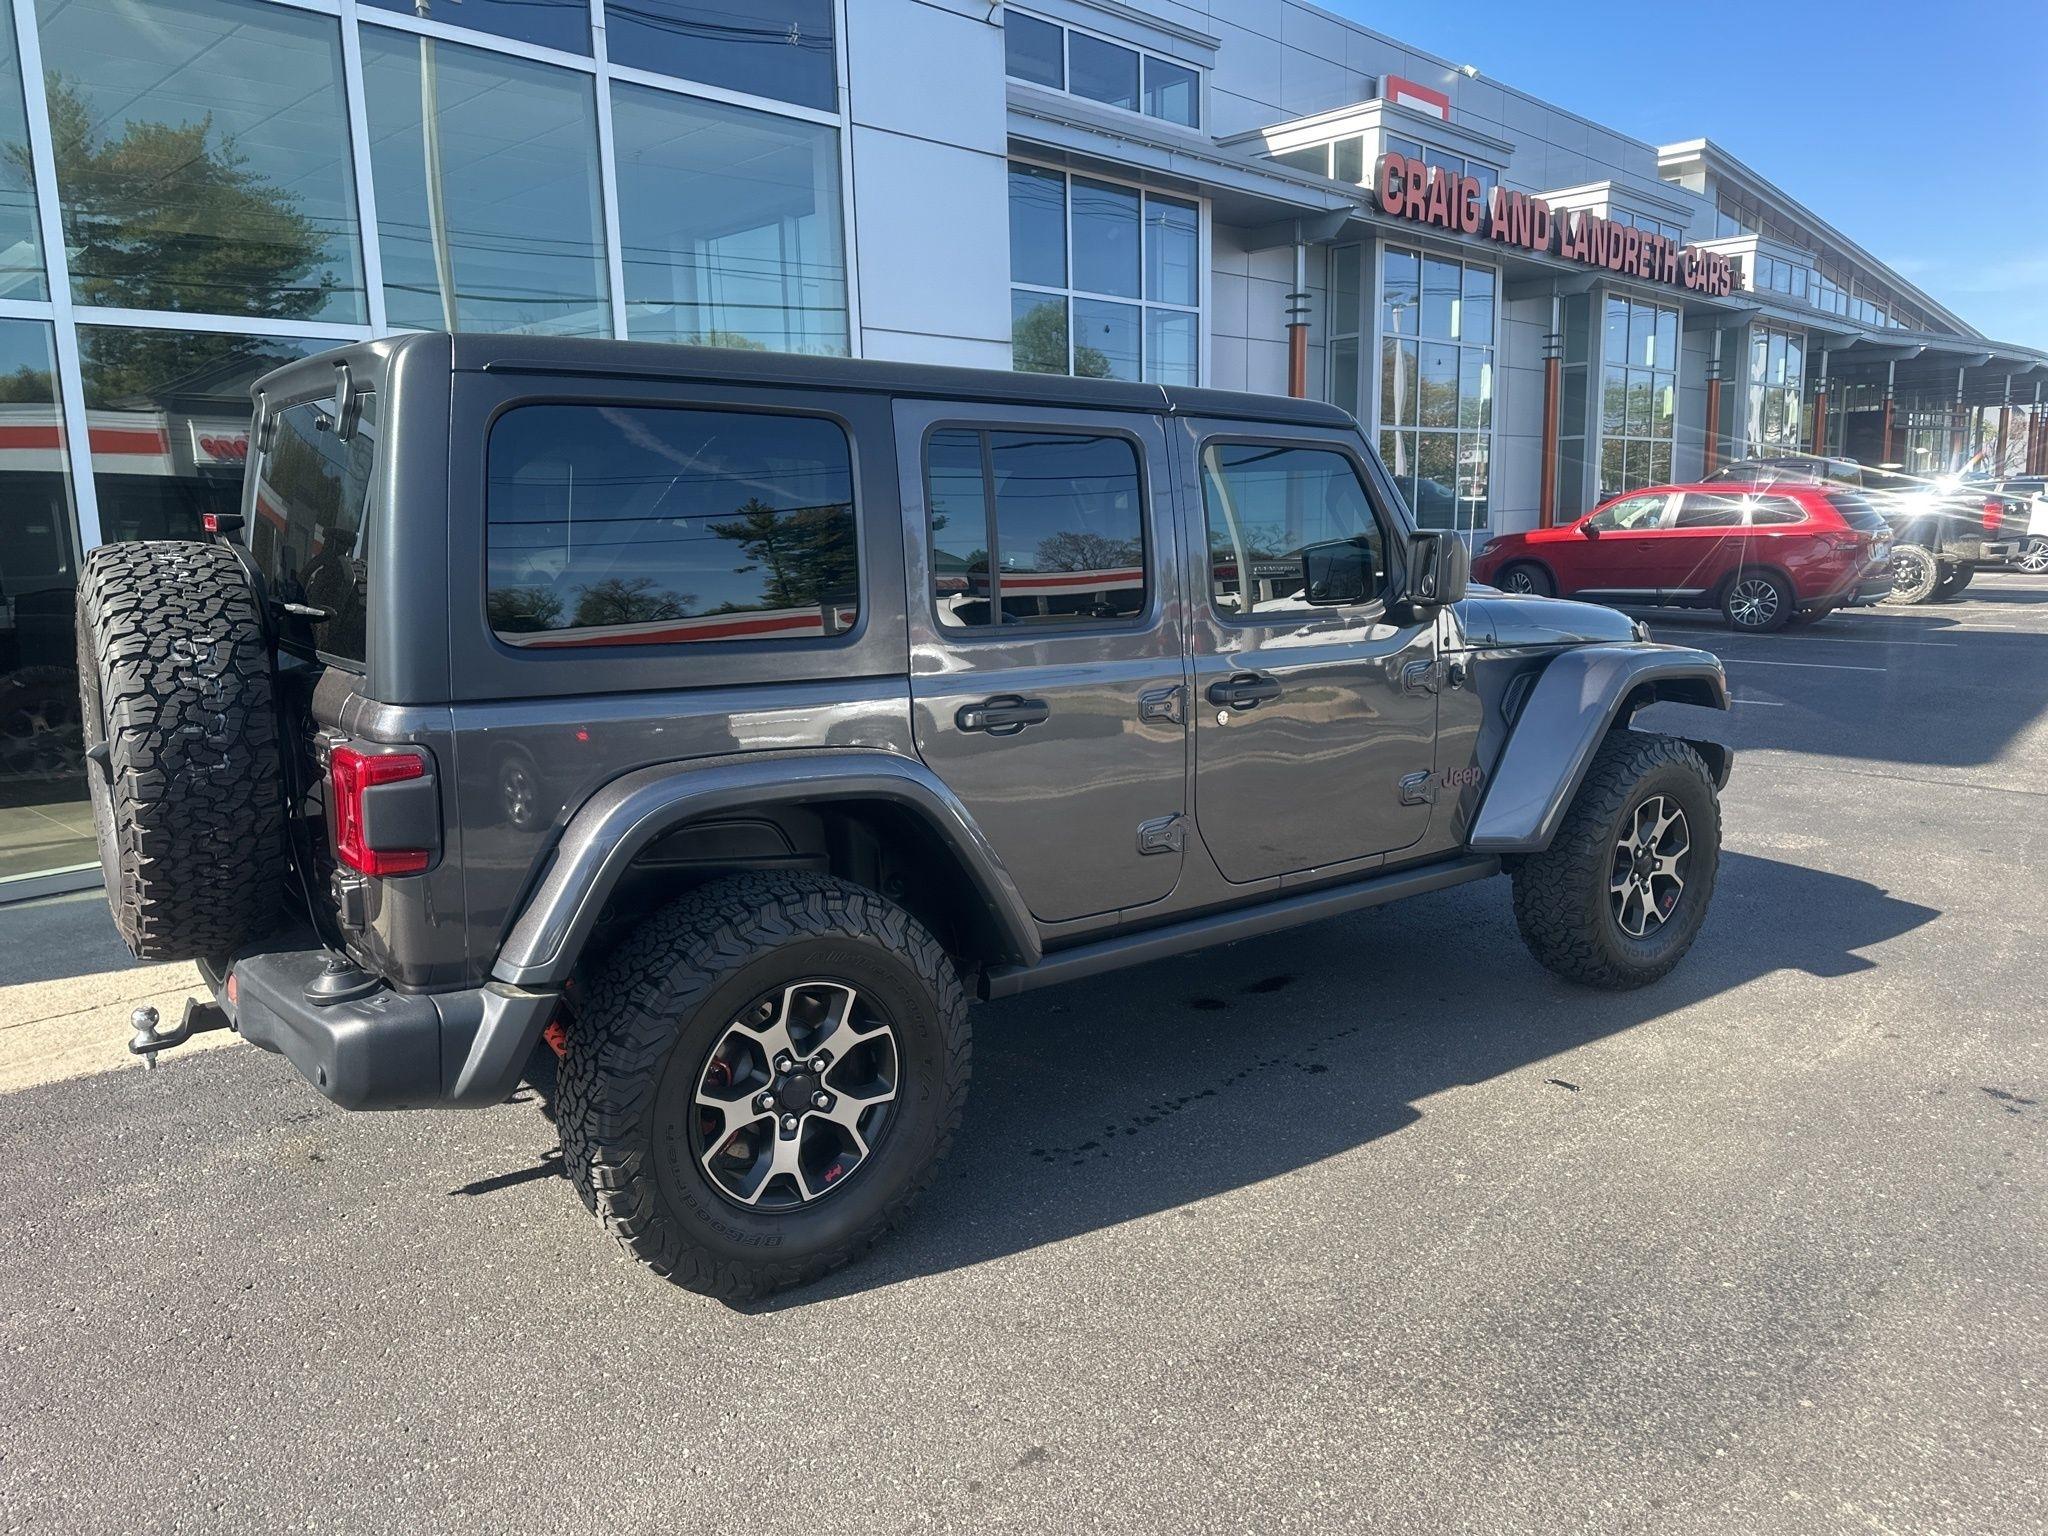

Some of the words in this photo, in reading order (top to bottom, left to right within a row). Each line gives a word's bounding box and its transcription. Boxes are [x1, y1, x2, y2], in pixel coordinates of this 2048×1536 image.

[1377, 151, 1482, 234] CRAIG
[1490, 184, 1551, 252] AND
[1558, 208, 1679, 284] LANDRETH
[1679, 245, 1731, 297] CARS
[1441, 766, 1482, 788] Jeep
[663, 1121, 786, 1249] BFGoodrich
